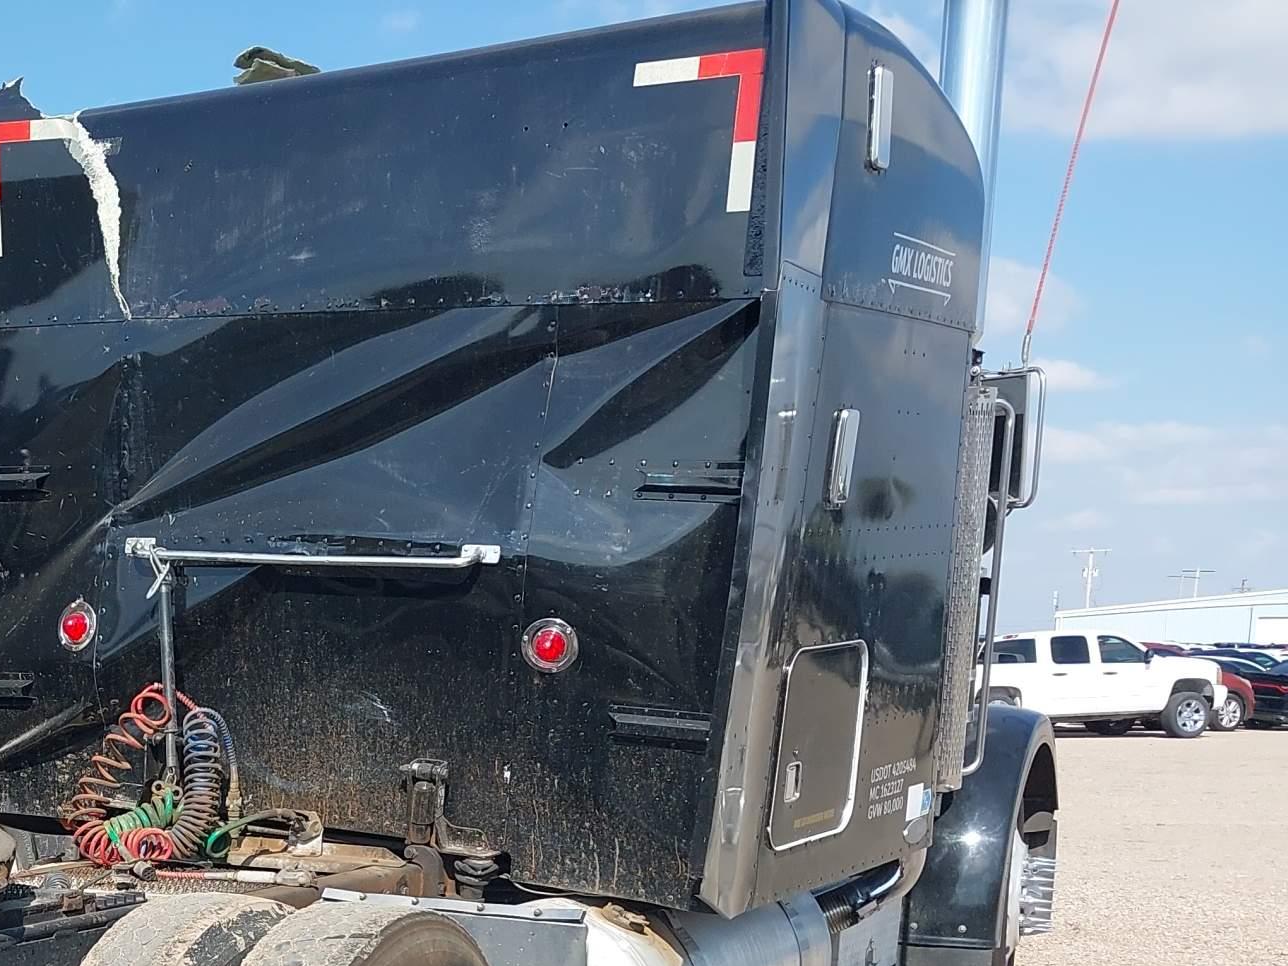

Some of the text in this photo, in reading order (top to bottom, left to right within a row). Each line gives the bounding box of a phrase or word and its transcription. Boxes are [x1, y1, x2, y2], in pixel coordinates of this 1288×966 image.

[892, 244, 953, 287] GMX LOGISTICS
[870, 764, 892, 783] USDOT
[869, 785, 880, 801] MC
[867, 802, 883, 820] GVW
